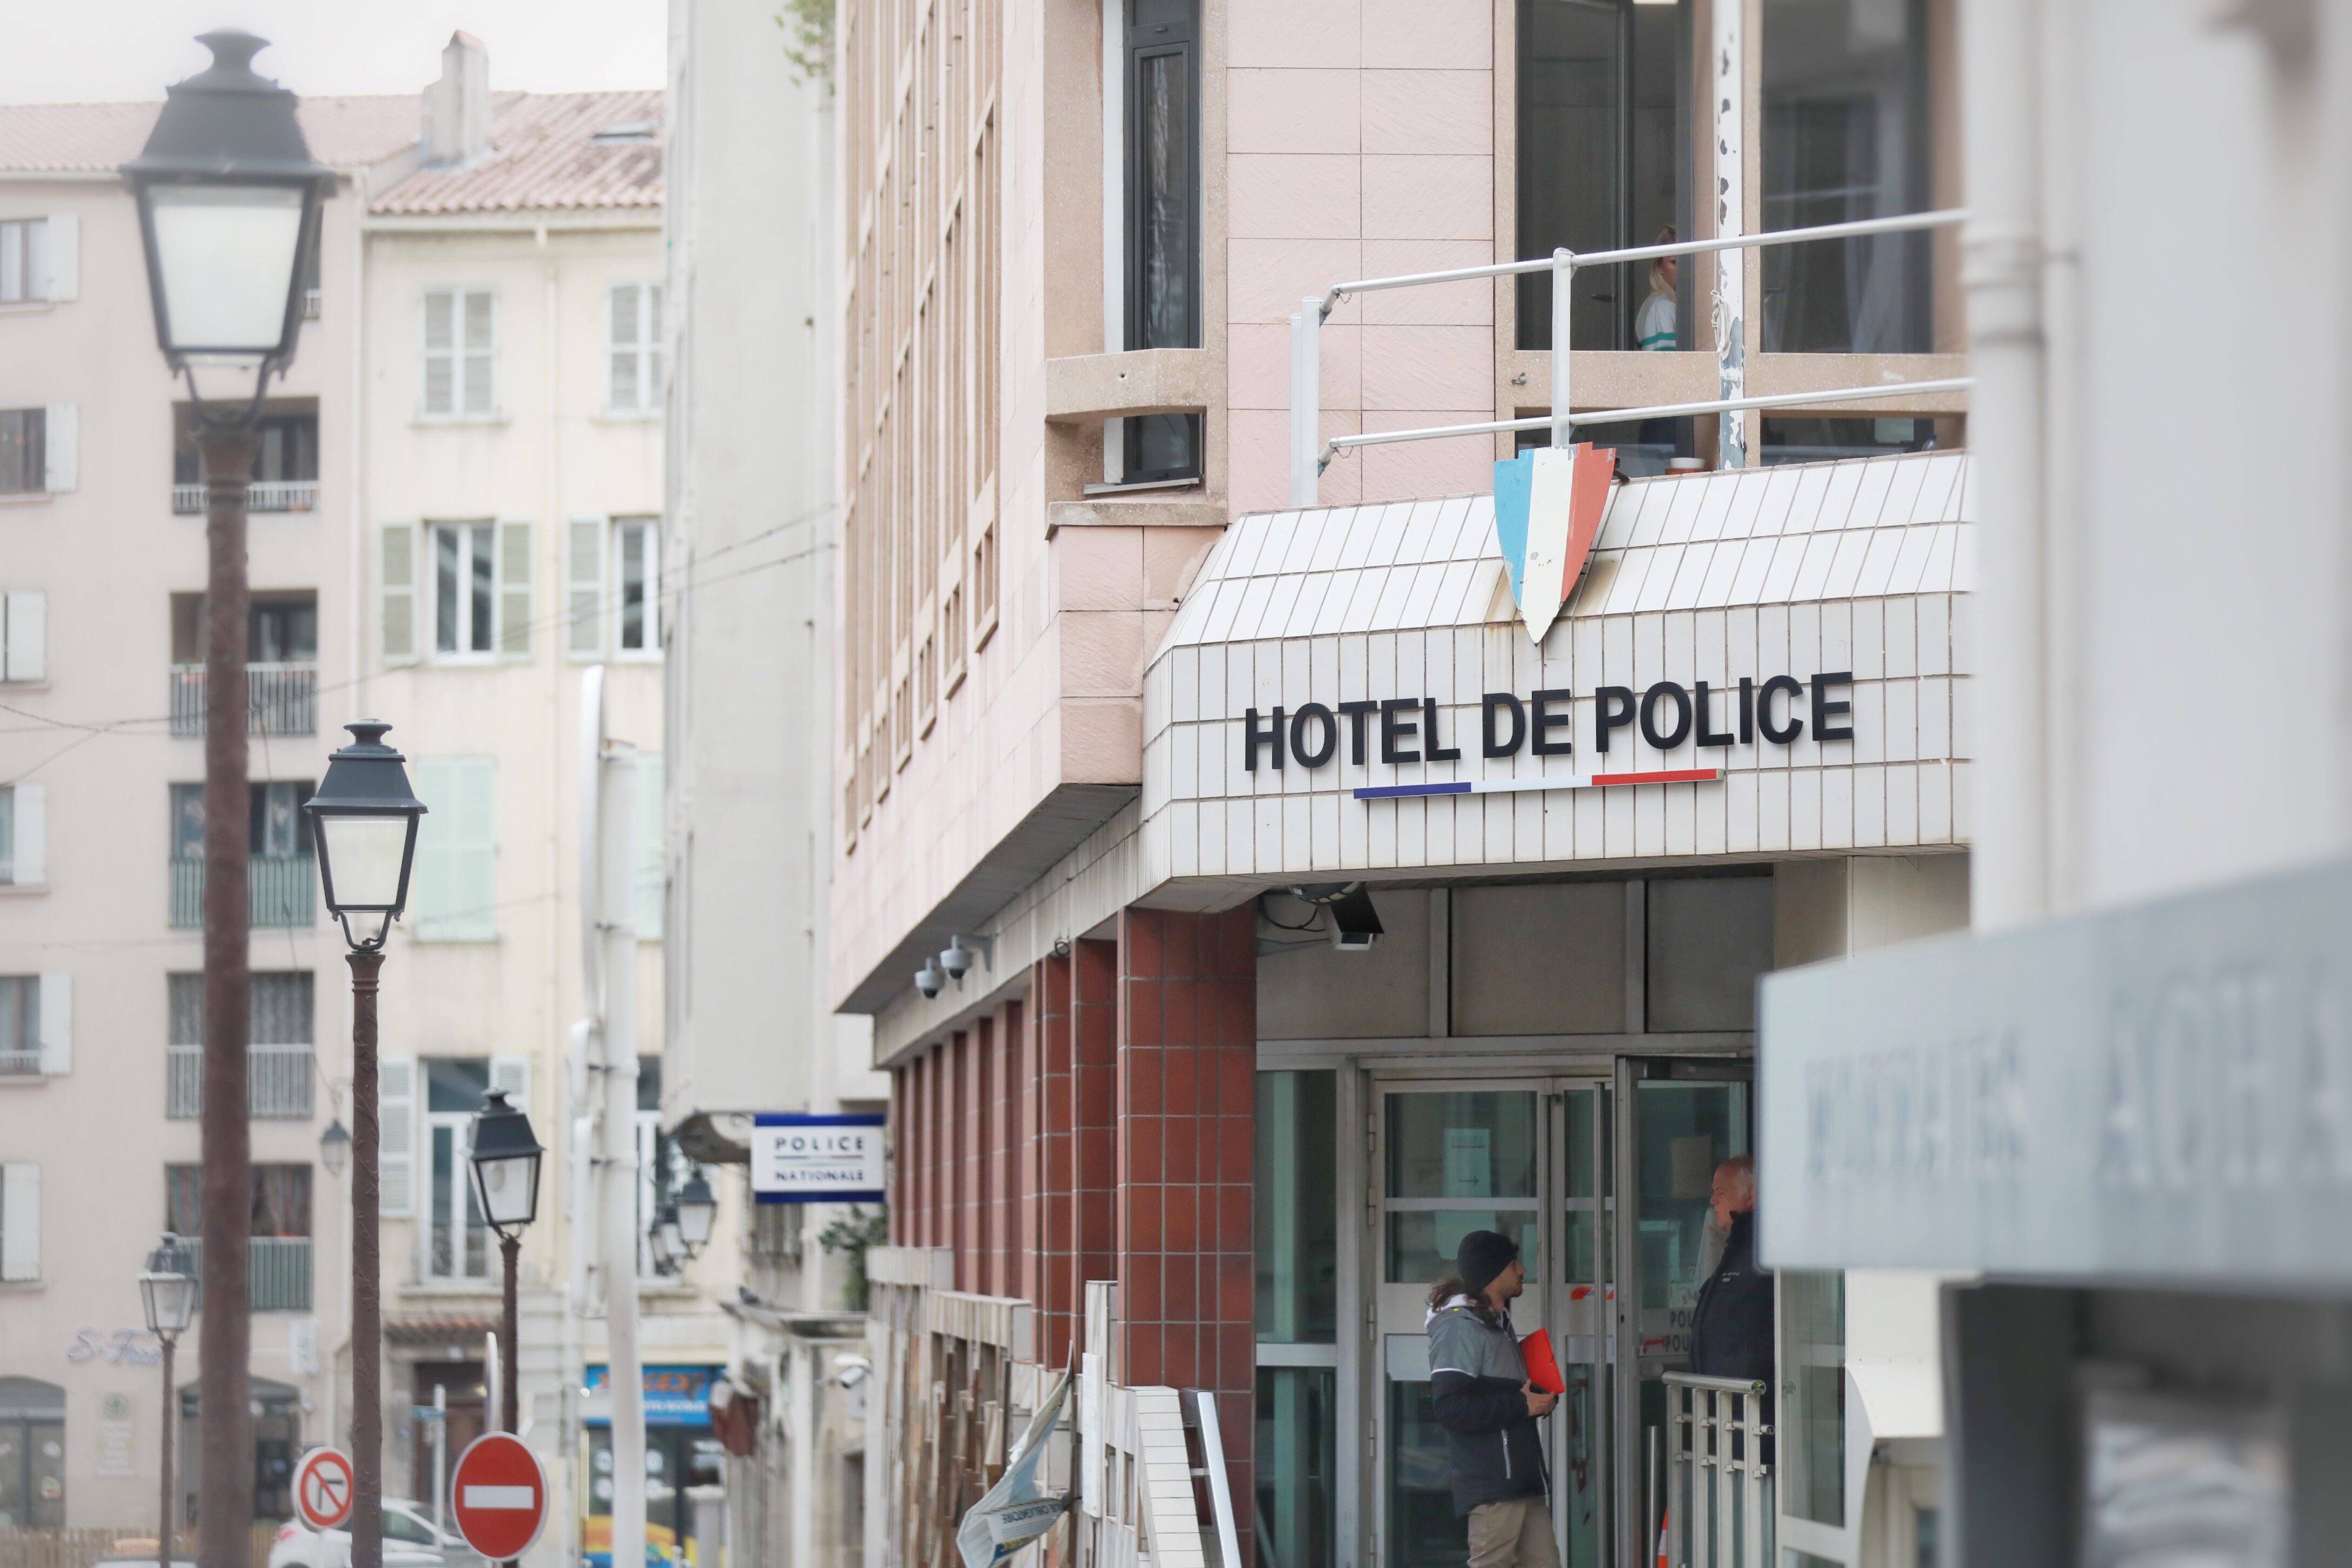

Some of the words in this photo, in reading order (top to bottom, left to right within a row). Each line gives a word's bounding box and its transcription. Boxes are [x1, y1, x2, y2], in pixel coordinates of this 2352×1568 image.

[1244, 697, 1461, 772] HOTEL
[1482, 688, 1571, 758] DE
[1595, 671, 1854, 753] POLICE
[775, 1137, 863, 1151] POLICE
[775, 1170, 863, 1181] NATIONALE
